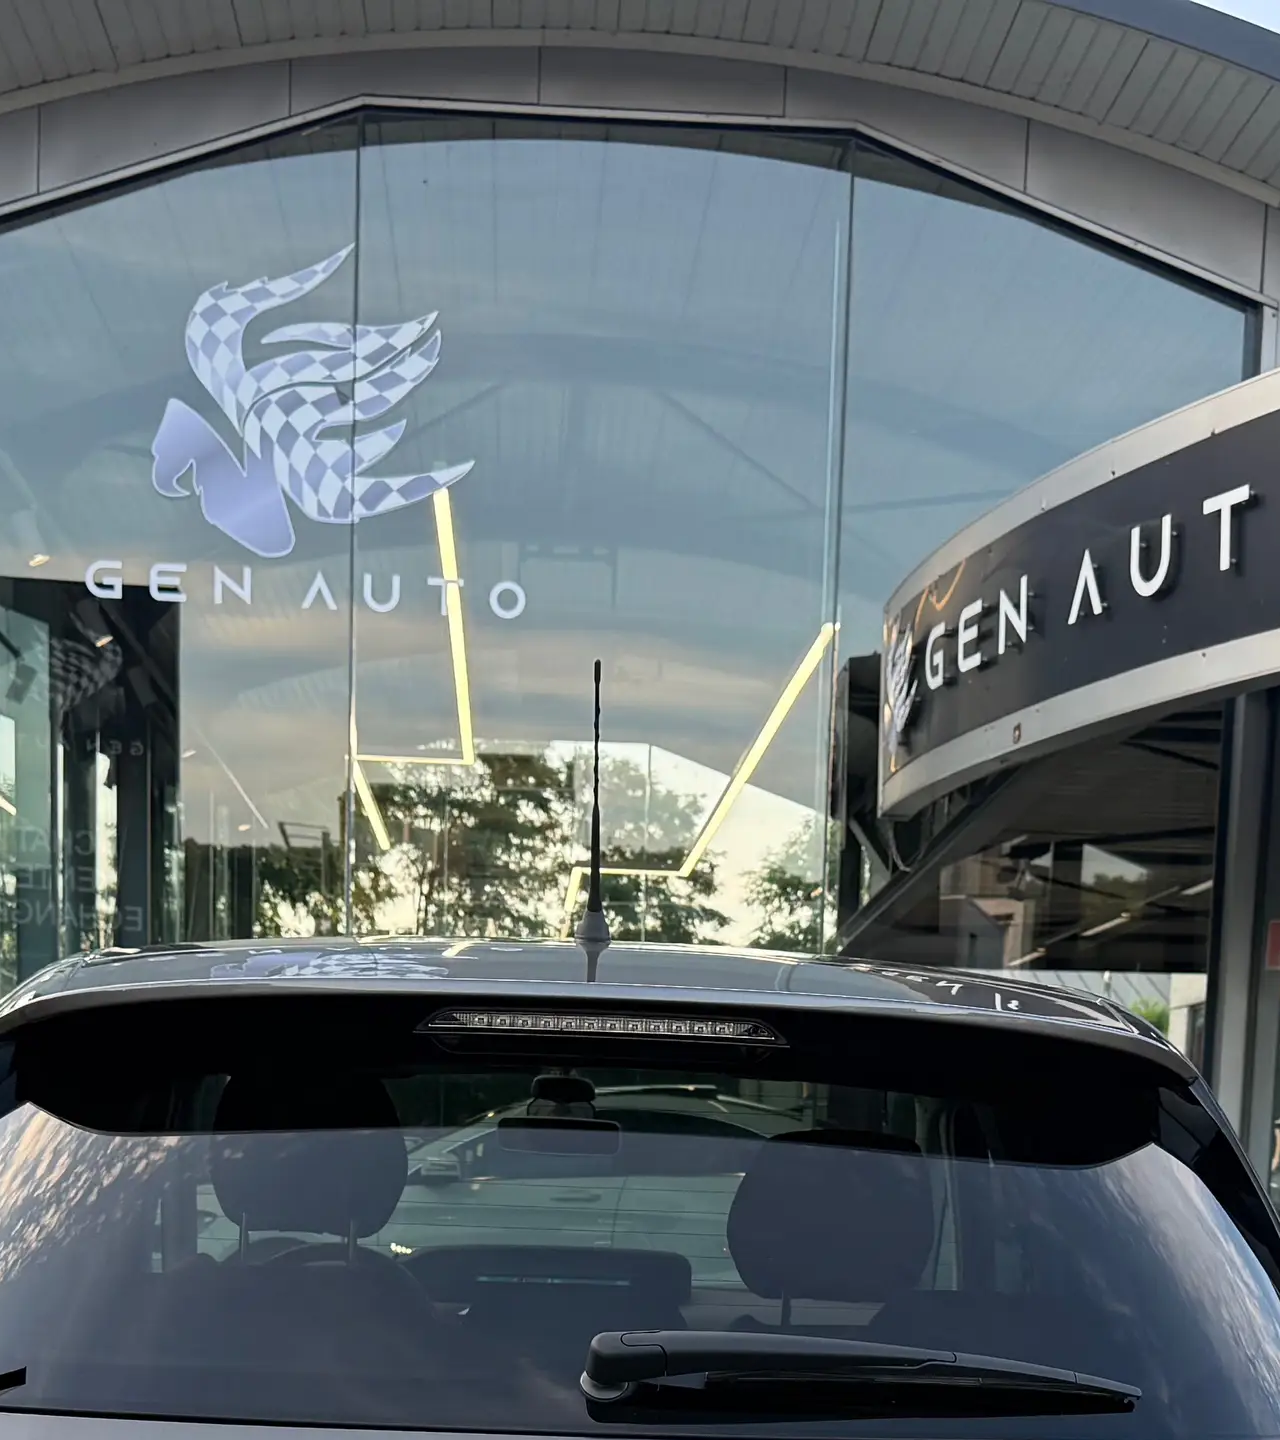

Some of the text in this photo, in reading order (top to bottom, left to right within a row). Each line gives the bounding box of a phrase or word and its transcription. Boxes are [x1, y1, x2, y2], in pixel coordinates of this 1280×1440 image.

[84, 559, 527, 620] GEN AUTO
[925, 574, 1029, 690] GEN
